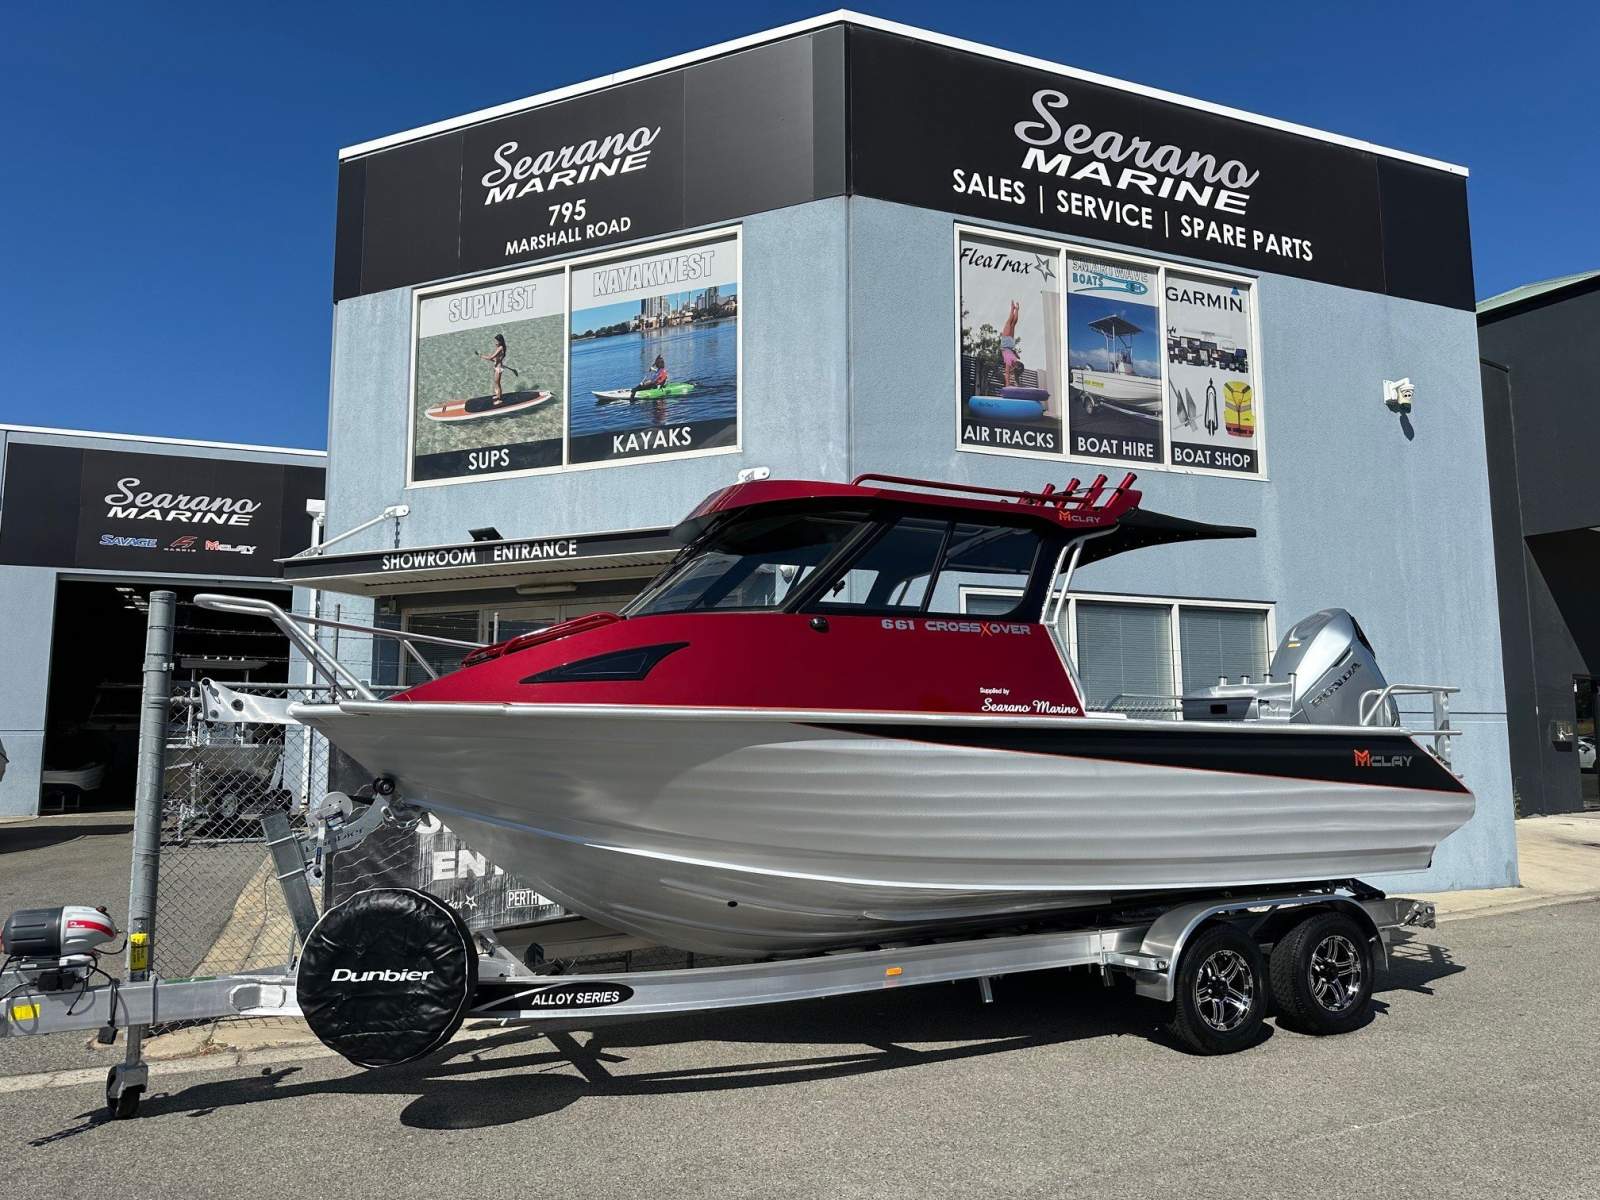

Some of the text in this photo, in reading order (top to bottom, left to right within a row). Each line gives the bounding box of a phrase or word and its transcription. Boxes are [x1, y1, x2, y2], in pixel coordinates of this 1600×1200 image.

[1013, 88, 1260, 189] Searano
[481, 125, 661, 188] Searano
[484, 150, 652, 206] MARINE
[1021, 147, 1251, 215] MARINE
[548, 199, 587, 227] 795
[952, 167, 1313, 262] SALES SERVICE SPARE PARTS
[505, 216, 632, 256] MARSHALL ROAD
[593, 250, 716, 297] KAYAKWEST
[960, 248, 1032, 275] FleaTrax
[1072, 272, 1104, 288] BOATS
[449, 283, 537, 323] SUPWEST
[1166, 286, 1243, 313] GARMIN
[613, 427, 692, 454] KAYAKS
[963, 425, 1055, 449] AIR TRACKS
[1077, 437, 1154, 459] BOAT HIRE
[468, 449, 509, 471] SUPS
[1174, 446, 1251, 469] BOAT SHOP
[104, 478, 261, 513] Searano
[107, 506, 252, 526] MARINE
[382, 539, 578, 571] SHOWROOM ENTRANCE
[881, 618, 915, 630] 661
[1002, 687, 1010, 695] by
[981, 697, 1079, 714] Searano Marine
[508, 890, 539, 907] PERTH
[331, 967, 434, 984] Dunbier
[532, 990, 620, 1006] ALLOY SERIES
